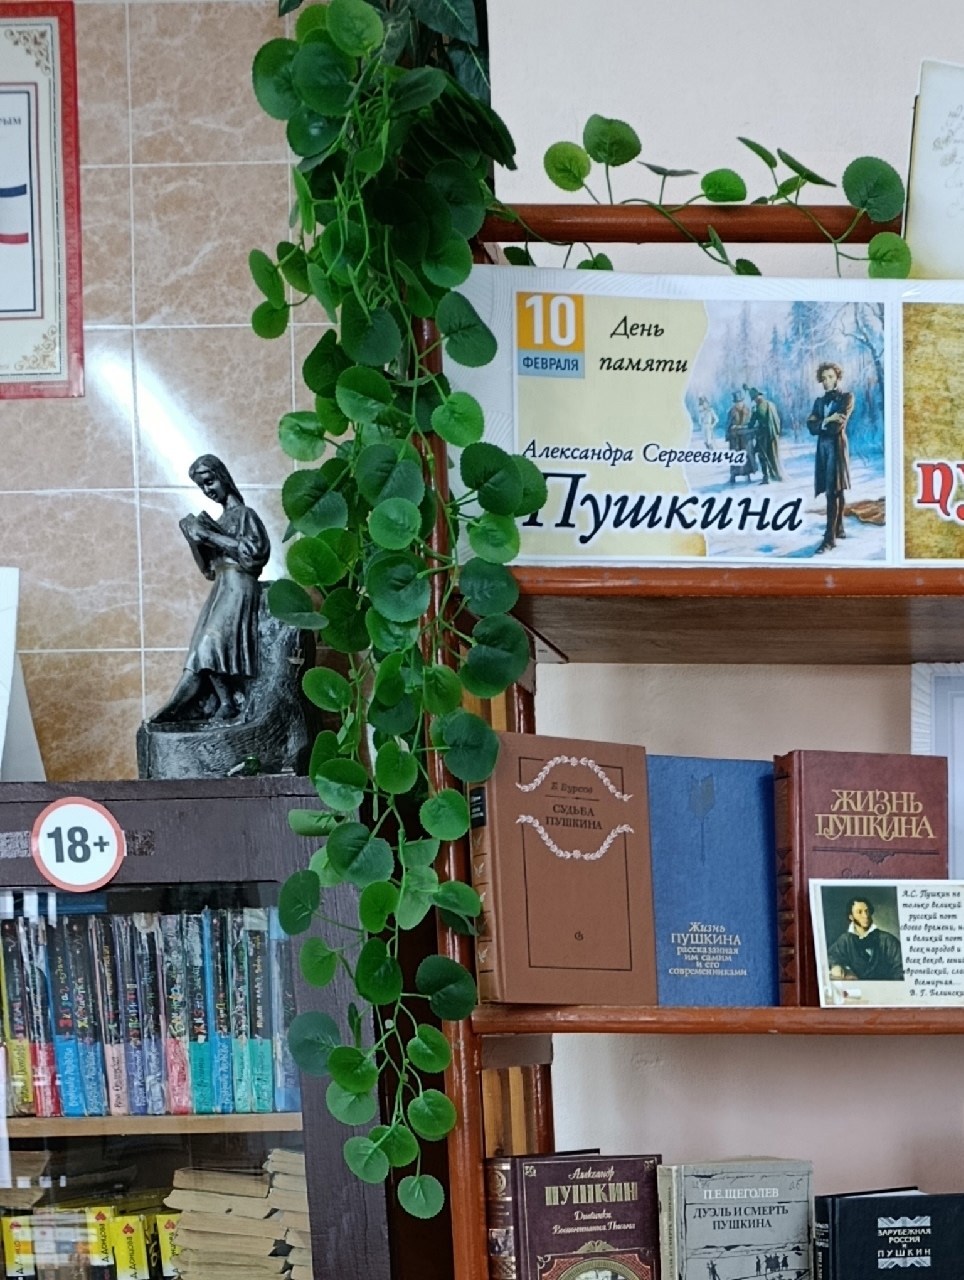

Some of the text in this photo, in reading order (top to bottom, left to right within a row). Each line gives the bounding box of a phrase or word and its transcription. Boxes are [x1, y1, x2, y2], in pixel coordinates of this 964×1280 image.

[525, 296, 578, 345] 10
[610, 315, 665, 339] День
[522, 354, 580, 373] ФЕВРАЛЯ
[599, 355, 688, 374] памяти
[522, 439, 746, 467] Александра Сергеевича
[523, 472, 803, 543] Пушкина
[831, 789, 923, 816] ЖИЗНЬ
[552, 803, 595, 818] СУДЬБА
[545, 816, 603, 831] ПУШКИНА
[814, 813, 936, 840] ПУШКИНА
[47, 826, 109, 863] 18+
[920, 891, 950, 899] Пушкин
[903, 902, 929, 910] только
[908, 913, 937, 922] русский
[689, 921, 726, 935] Жизнь
[924, 923, 955, 932] времени,
[670, 932, 742, 947] ПУШКИНА
[676, 944, 739, 956] рассказанная
[909, 946, 925, 954] всех
[684, 954, 732, 963] им самим
[705, 961, 720, 969] его
[905, 957, 921, 965] всех
[923, 957, 944, 965] веков,
[668, 966, 747, 977] современниками
[544, 1181, 638, 1207] ПУШКИН
[693, 1205, 789, 1219] ДУЭЛЬ И СМЕРТЬ
[712, 1218, 773, 1231] ПУШКИНА
[98, 1223, 108, 1254] Донцова
[877, 1228, 931, 1237] ЗАРУБЕЖНАЯ
[889, 1236, 920, 1244] РОССИЯ
[127, 1236, 136, 1270] Донцова
[877, 1248, 931, 1258] ПУШКИН
